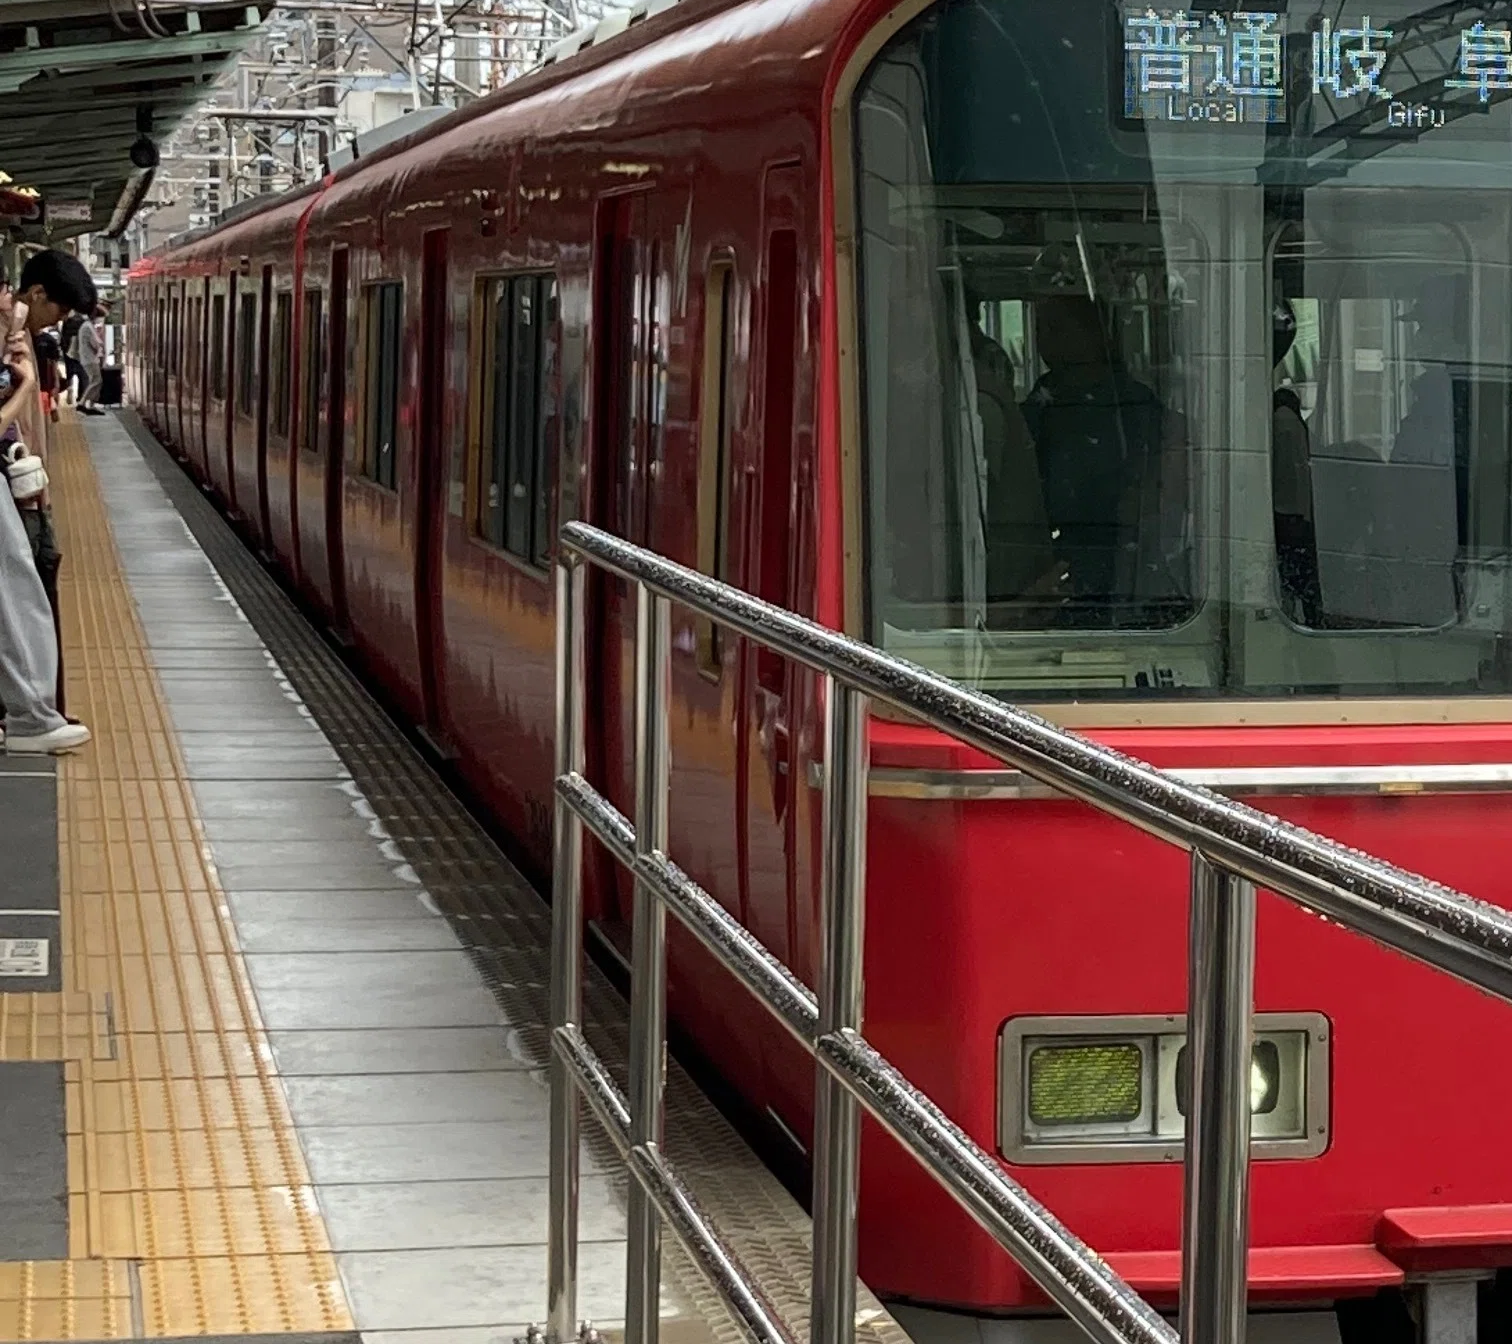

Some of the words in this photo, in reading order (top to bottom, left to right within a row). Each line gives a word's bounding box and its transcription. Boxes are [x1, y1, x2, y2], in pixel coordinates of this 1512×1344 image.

[1124, 6, 1285, 96] 普通
[1168, 95, 1245, 123] Local
[1387, 100, 1446, 128] Gifu
